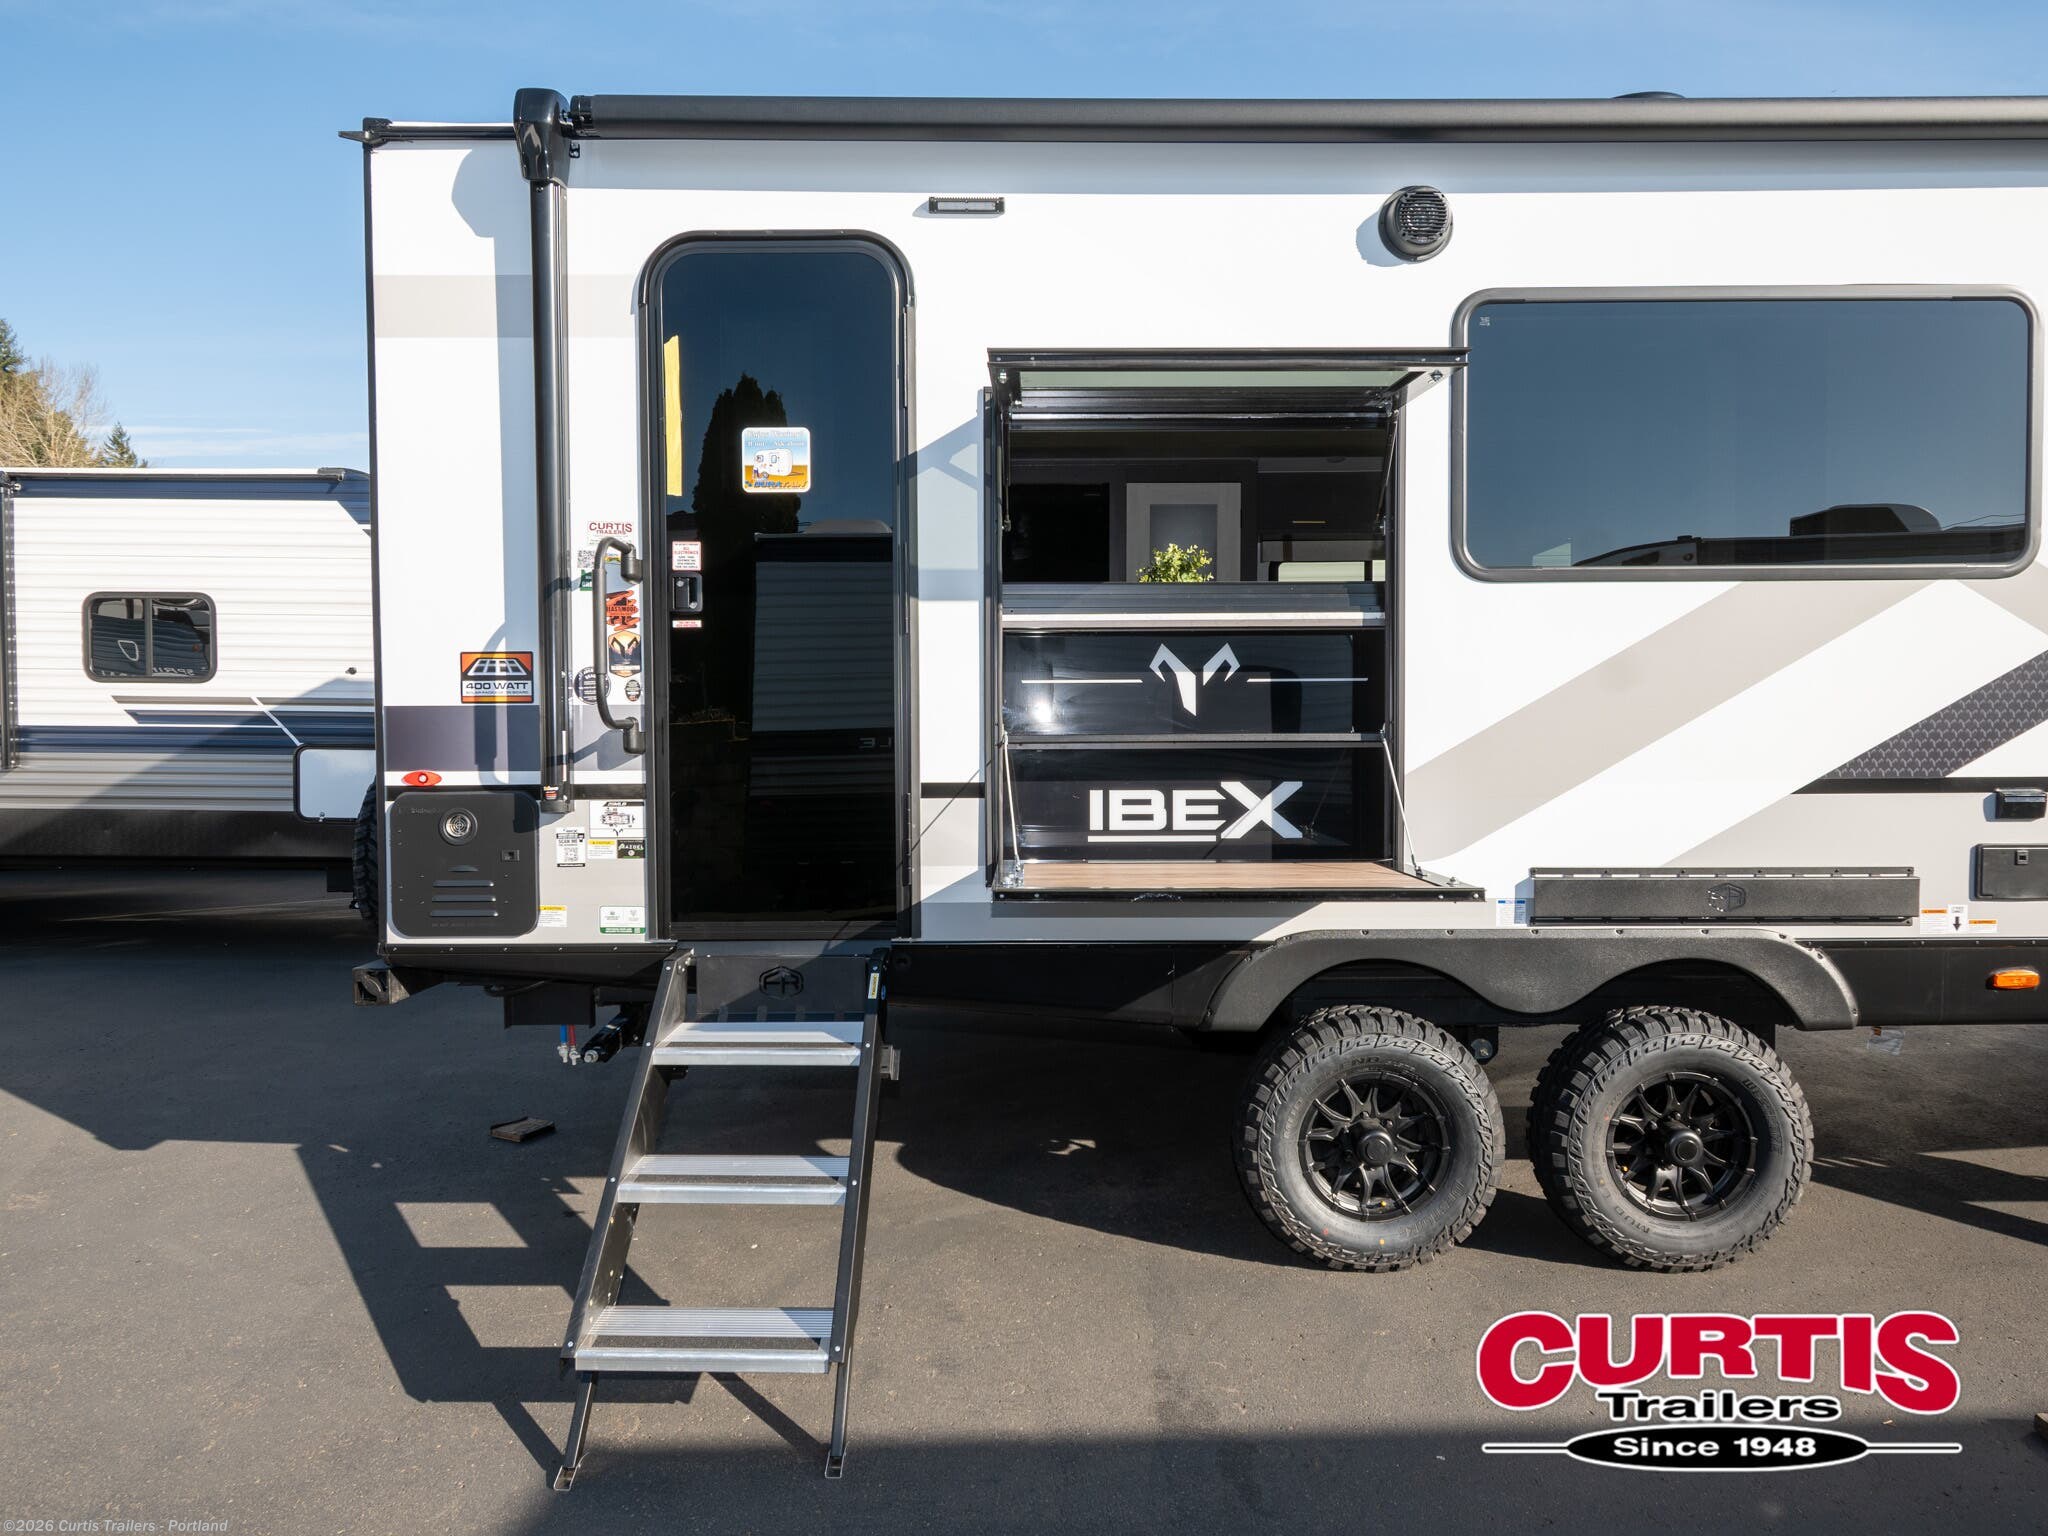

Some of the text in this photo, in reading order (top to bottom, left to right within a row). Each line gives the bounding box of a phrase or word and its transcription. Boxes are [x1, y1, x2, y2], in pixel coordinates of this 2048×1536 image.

[589, 522, 633, 533] CURTIS
[466, 682, 529, 690] 400 WATT
[1089, 781, 1304, 839] IBEX
